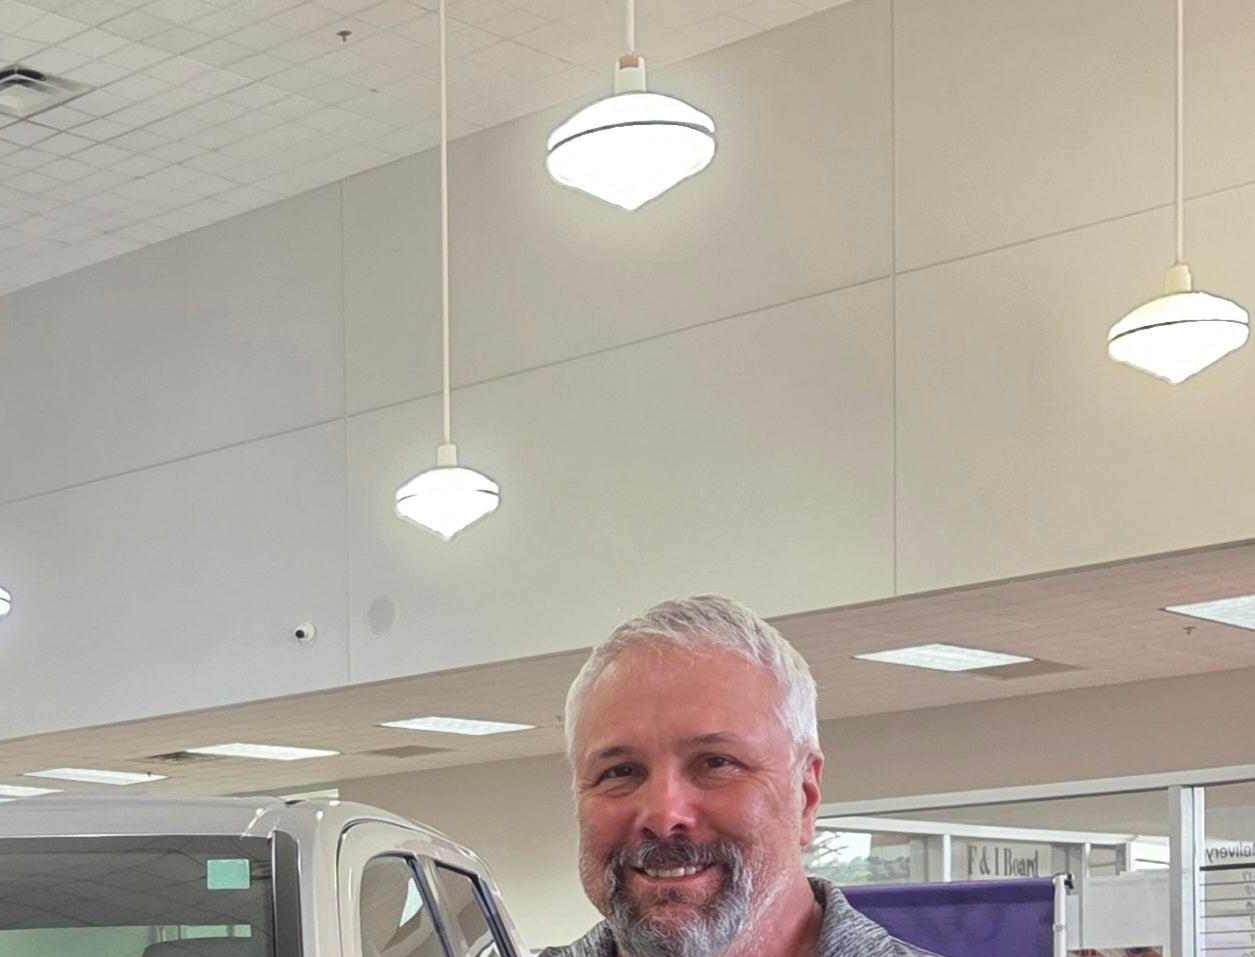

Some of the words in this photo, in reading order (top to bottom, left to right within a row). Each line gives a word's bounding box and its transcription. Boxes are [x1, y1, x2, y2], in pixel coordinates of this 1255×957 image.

[967, 845, 977, 875] F
[979, 846, 991, 876] &
[1003, 847, 1040, 879] Board
